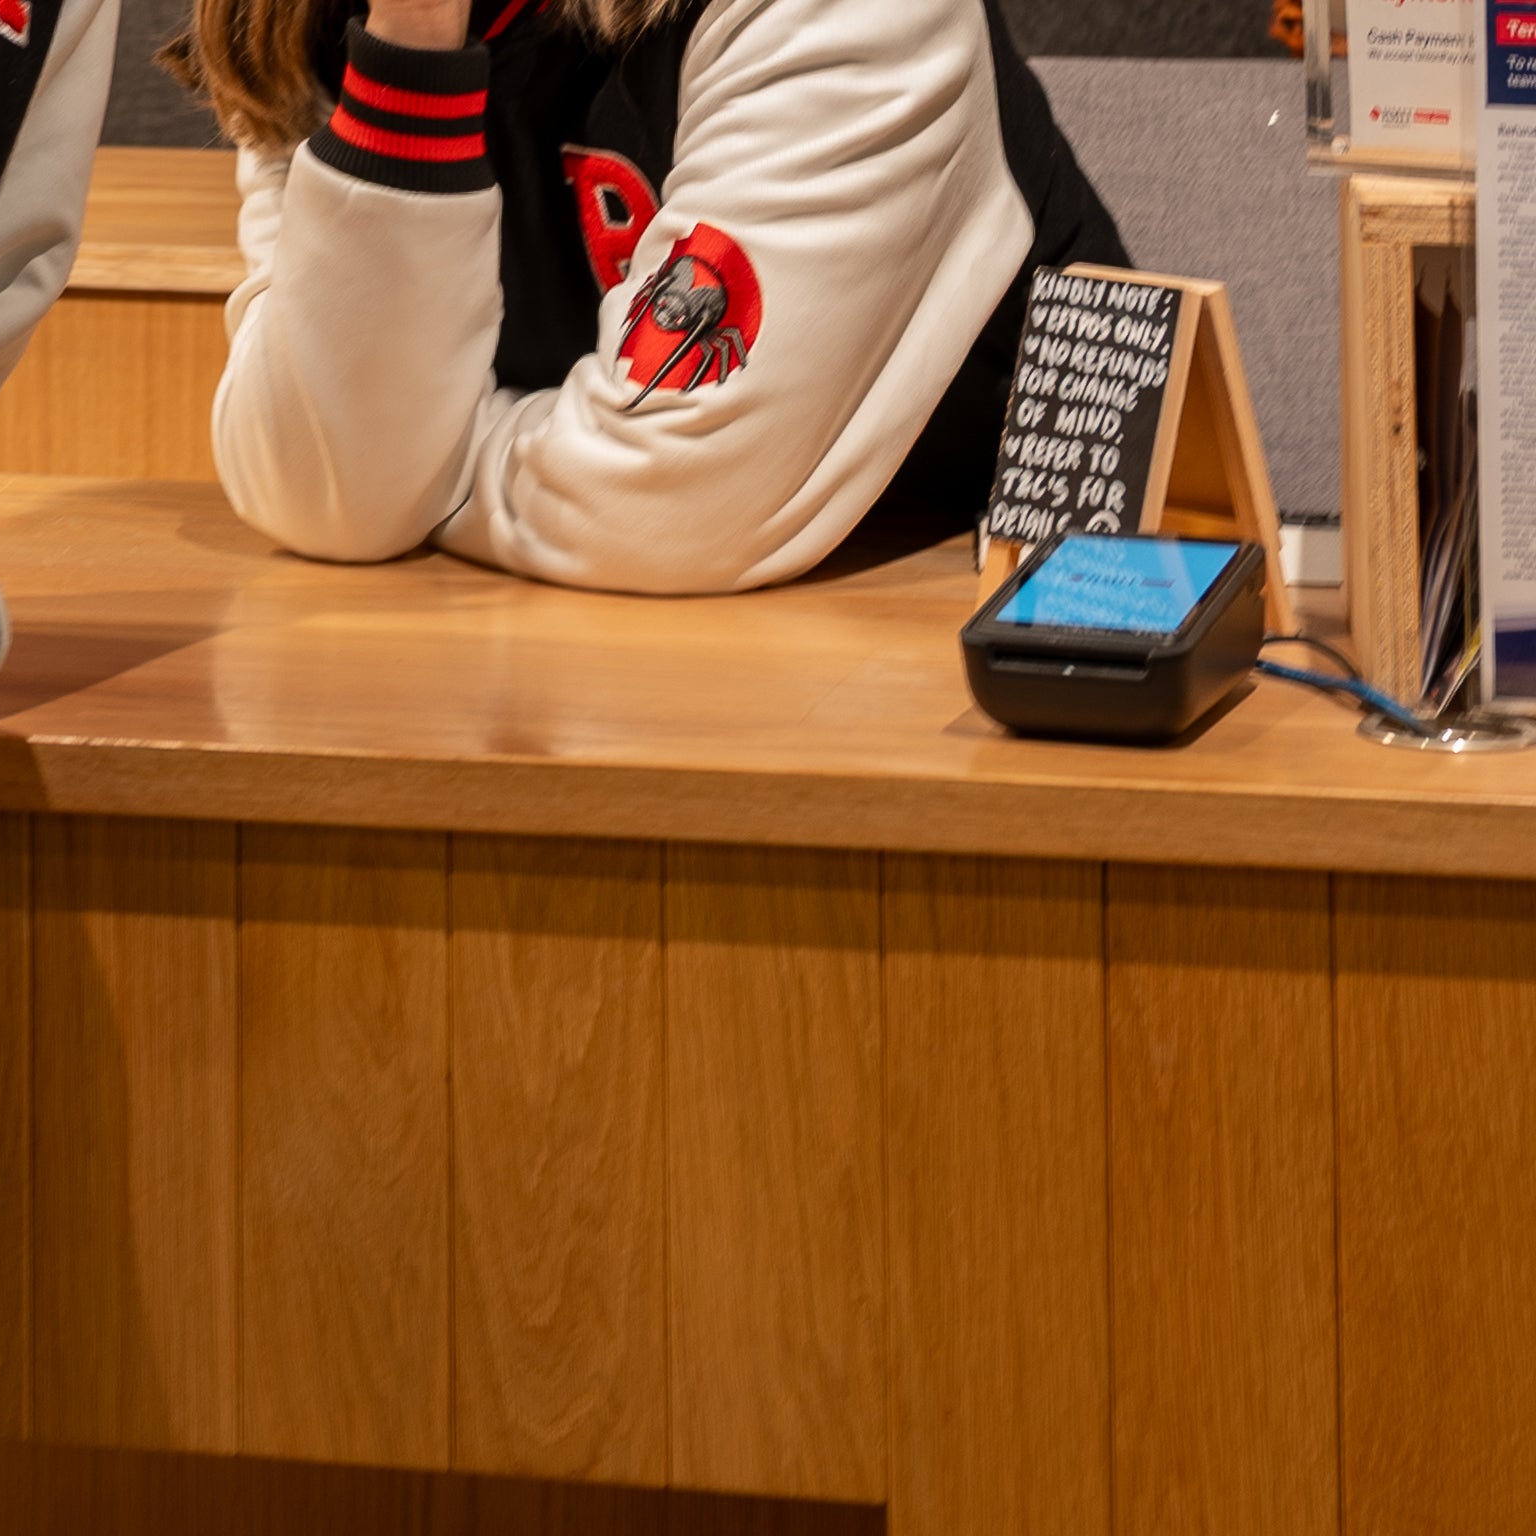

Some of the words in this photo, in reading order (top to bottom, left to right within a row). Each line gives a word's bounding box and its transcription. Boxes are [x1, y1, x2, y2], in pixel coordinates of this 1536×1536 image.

[1031, 273, 1107, 308] KINDLY
[1037, 334, 1072, 367] NO
[1068, 340, 1168, 388] REFUNDS
[1017, 362, 1059, 396] FOR
[1058, 371, 1139, 413] CHANGE
[1016, 397, 1048, 428] OF
[1018, 432, 1085, 471] REFER
[1088, 443, 1121, 476] TO
[1076, 475, 1126, 514] FOR
